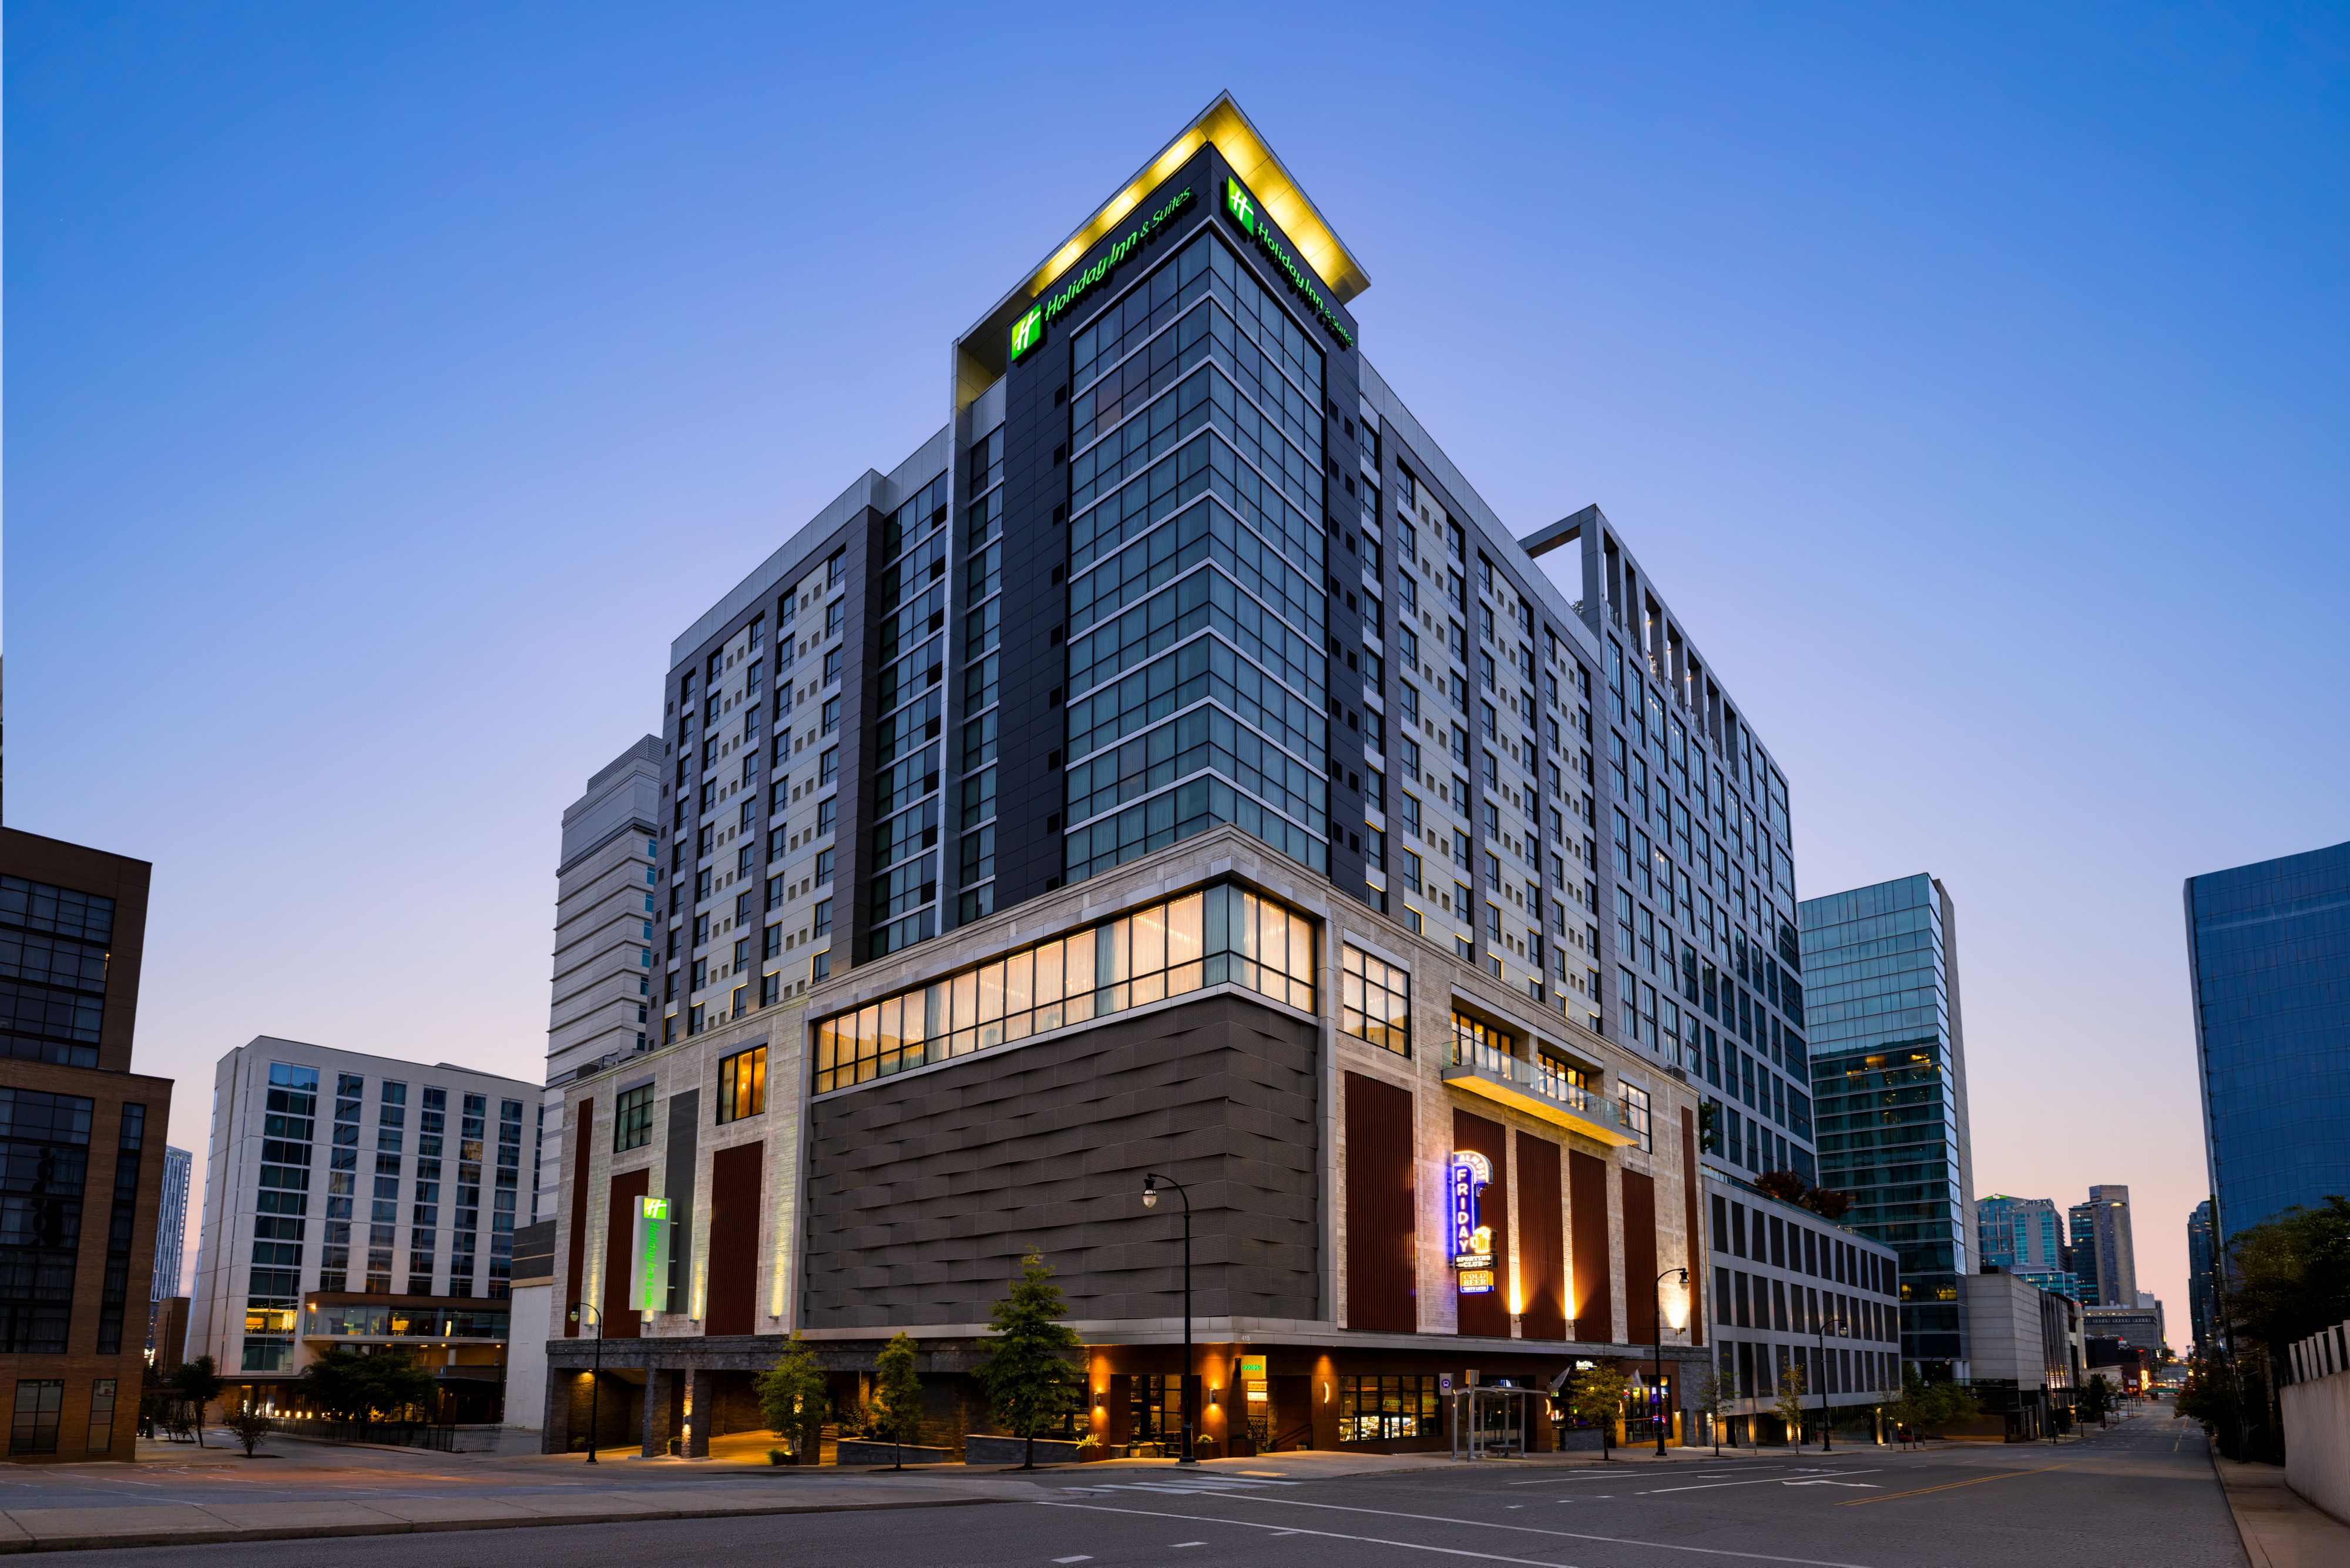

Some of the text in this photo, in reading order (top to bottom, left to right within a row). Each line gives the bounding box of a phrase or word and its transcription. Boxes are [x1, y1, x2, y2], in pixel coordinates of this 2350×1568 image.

[1045, 187, 1191, 321] Holiday Inn & Suites
[1257, 221, 1353, 347] Holiday Inn & Suites
[1459, 1154, 1486, 1180] ALMOST
[1457, 1169, 1469, 1253] FRIDAY
[644, 1221, 661, 1262] Holiday
[646, 1262, 659, 1279] Inn
[644, 1288, 653, 1309] Suites
